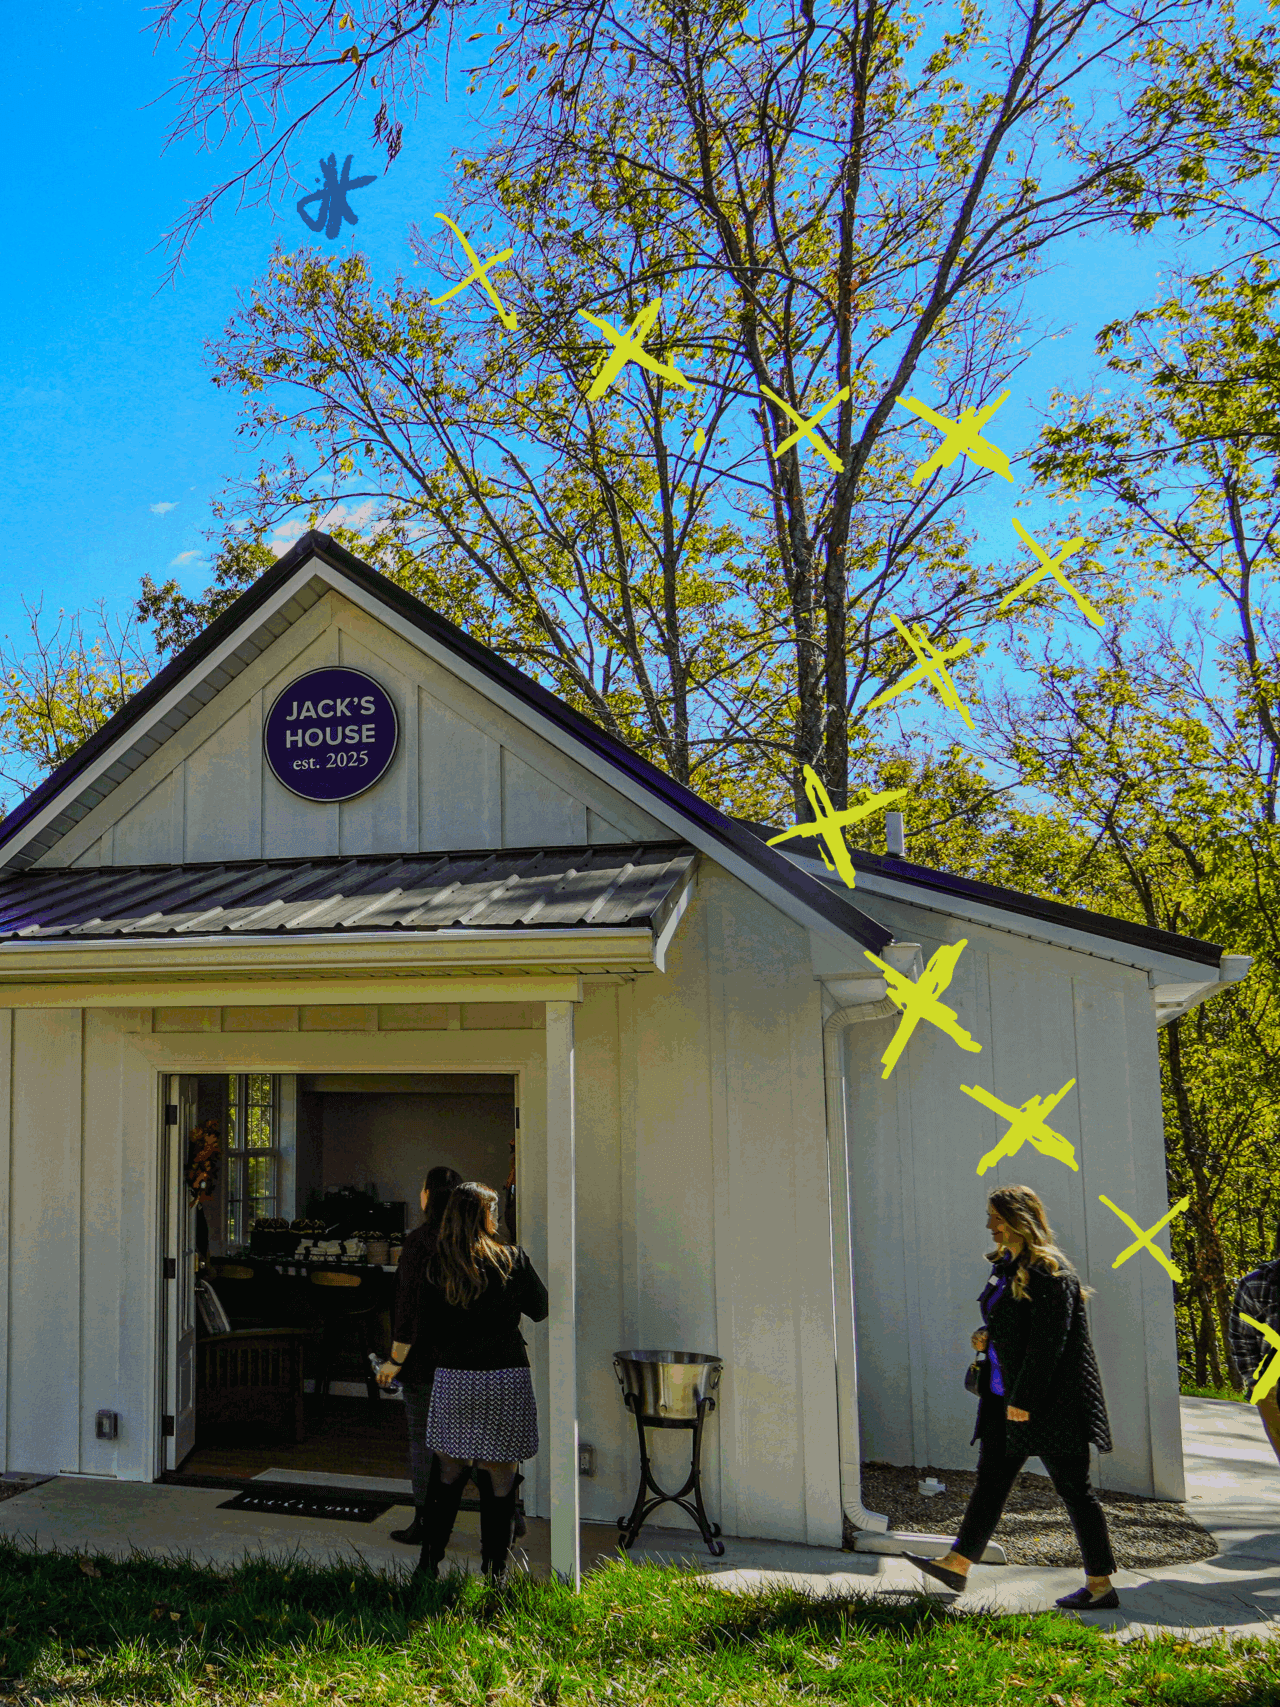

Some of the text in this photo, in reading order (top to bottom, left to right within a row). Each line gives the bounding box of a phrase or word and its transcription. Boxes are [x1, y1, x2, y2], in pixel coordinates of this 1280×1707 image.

[285, 696, 376, 721] JACK'S
[285, 723, 376, 749] HOUSE
[293, 750, 369, 770] est. 2025
